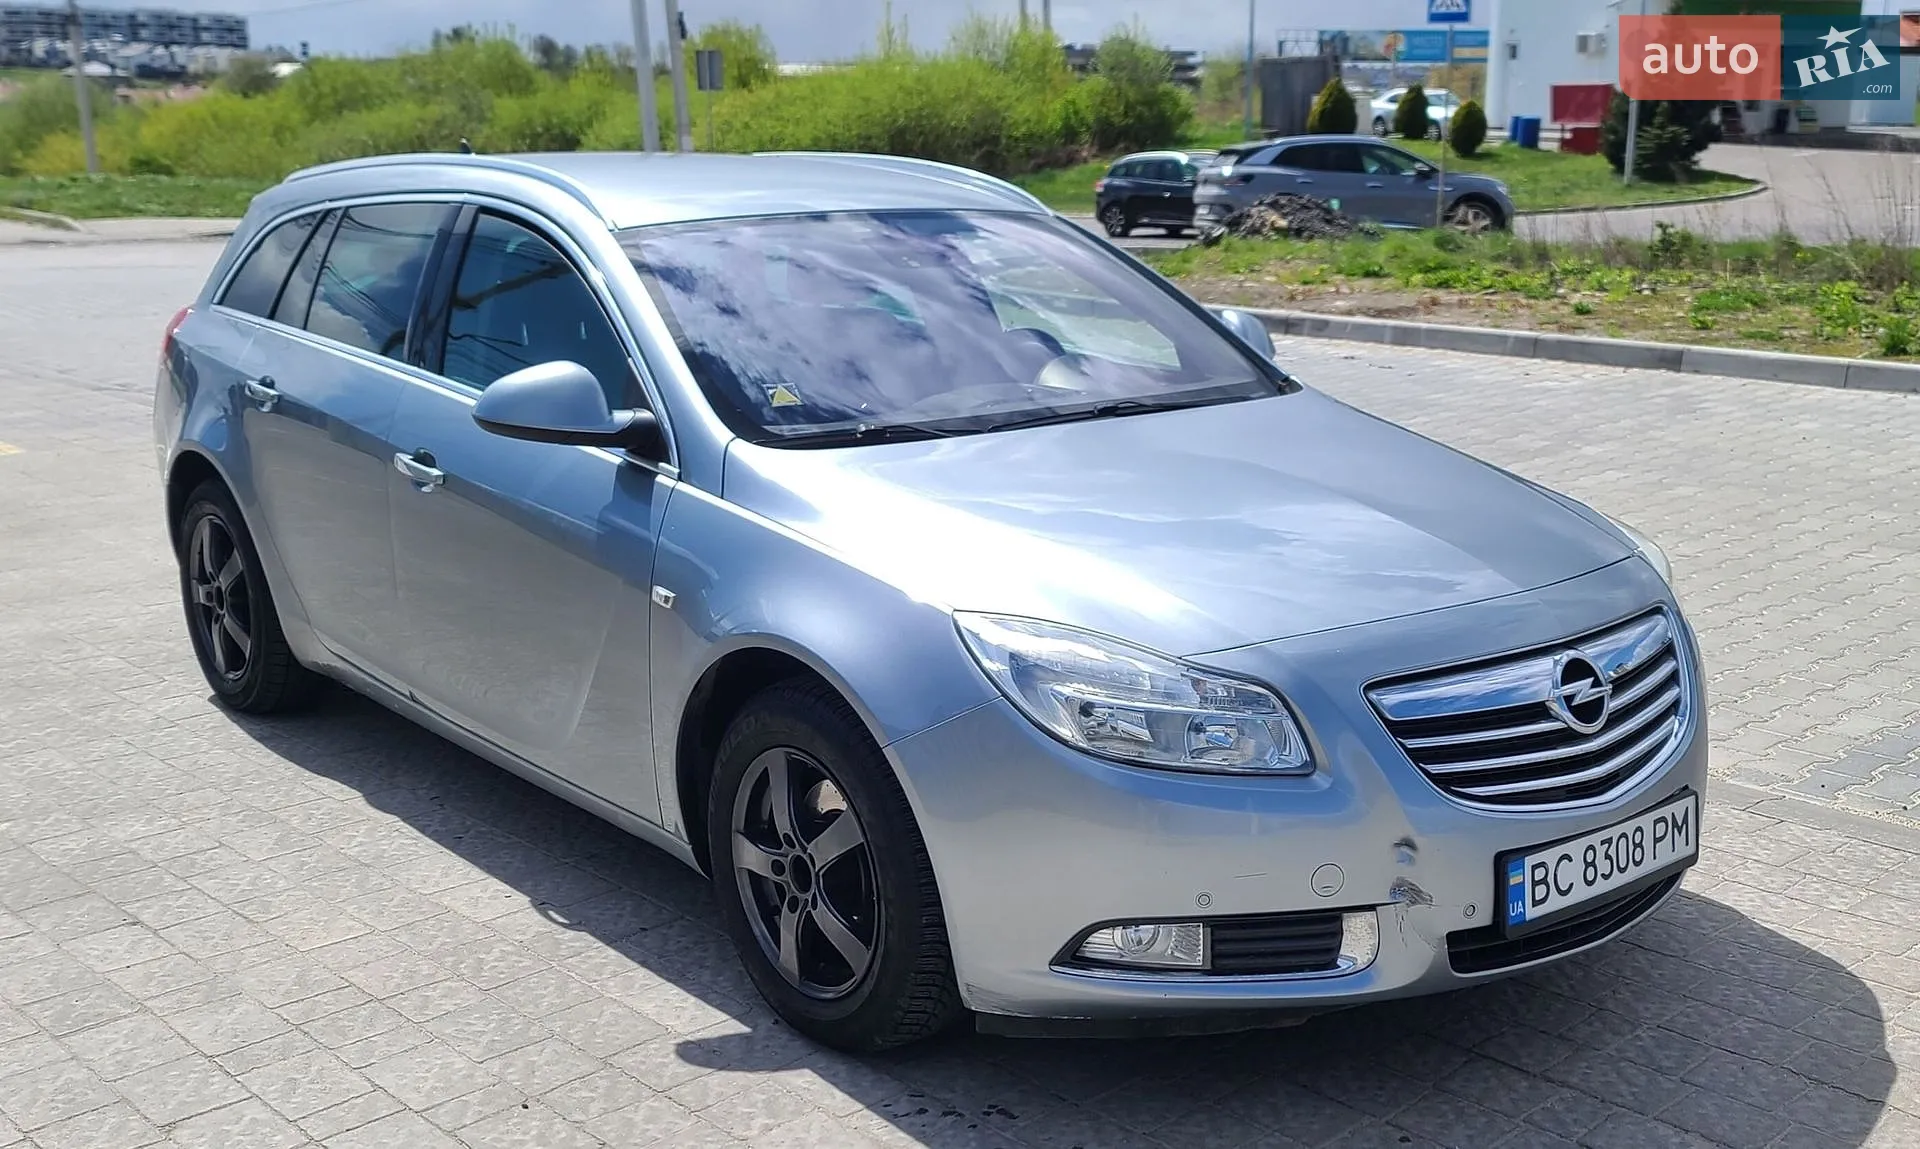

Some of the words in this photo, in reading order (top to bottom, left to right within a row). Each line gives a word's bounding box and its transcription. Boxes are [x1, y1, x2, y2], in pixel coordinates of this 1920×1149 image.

[1530, 853, 1574, 908] BC
[1582, 825, 1645, 887] 8308
[1652, 806, 1690, 861] PM
[1509, 900, 1524, 917] UA
